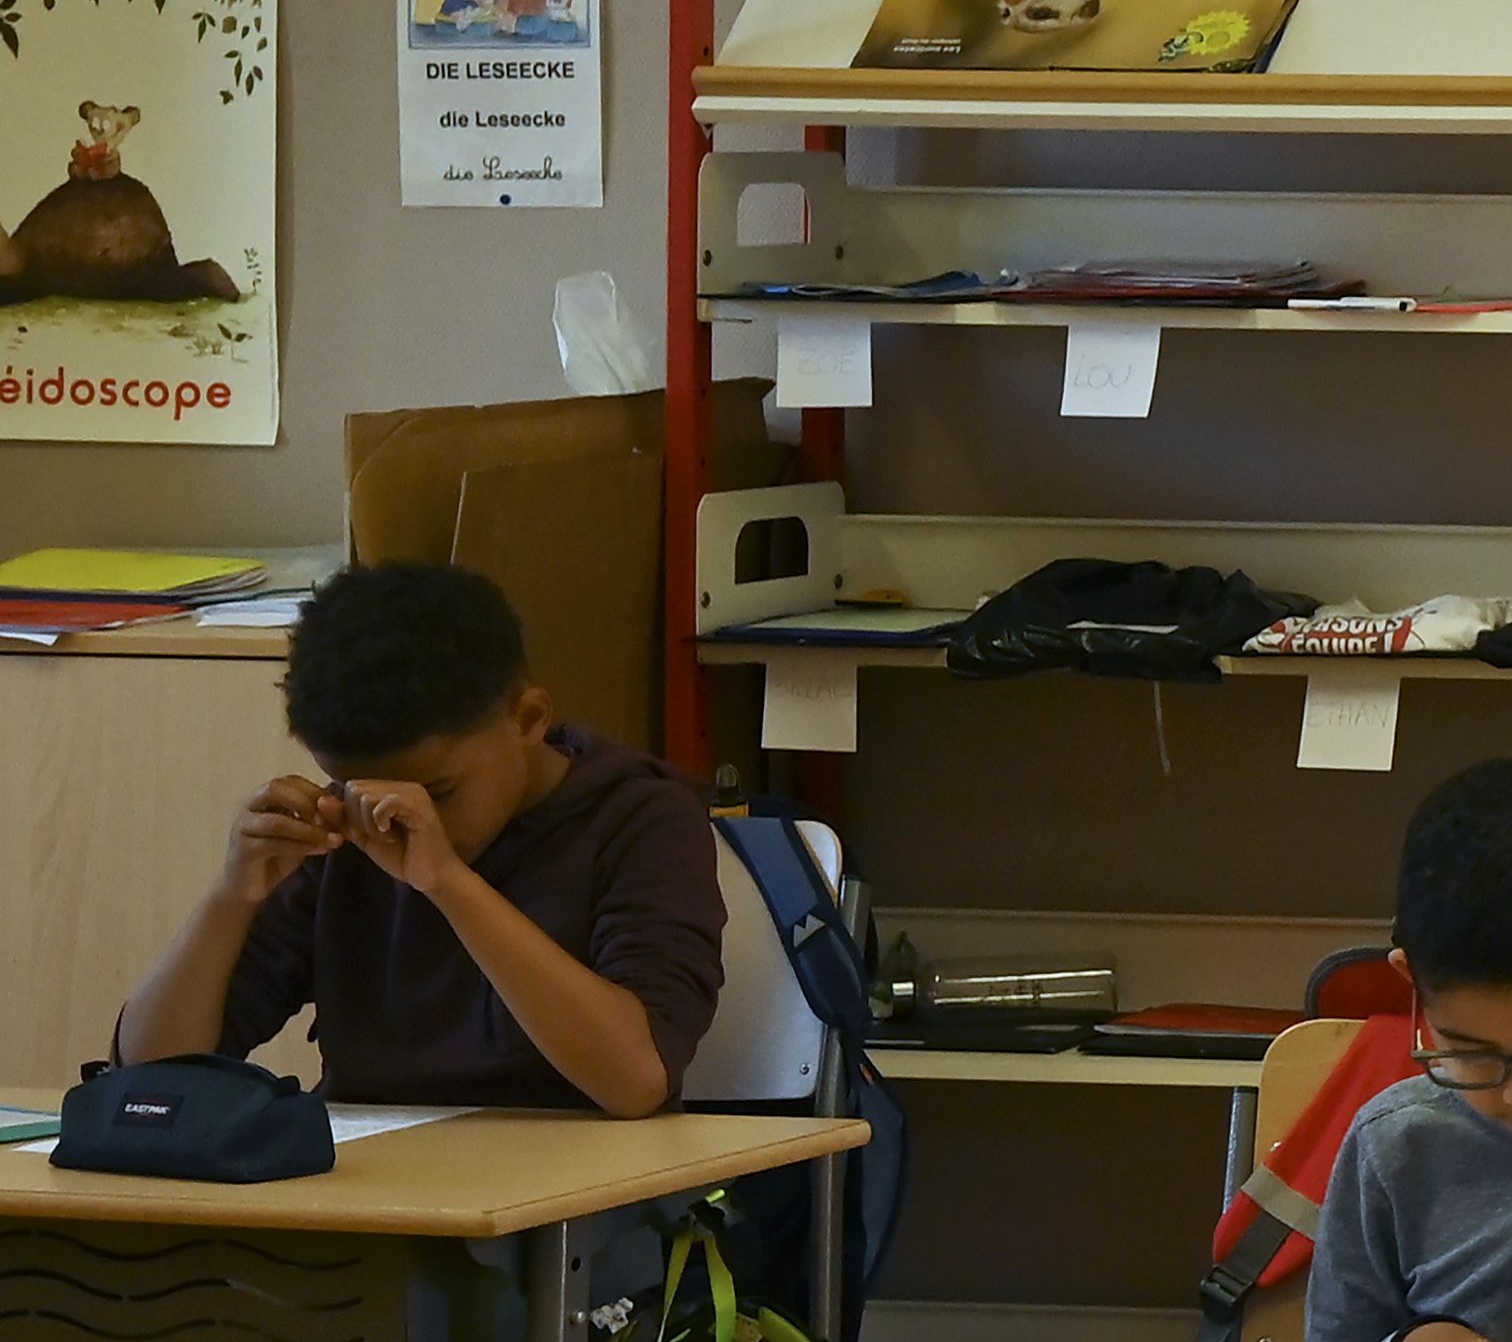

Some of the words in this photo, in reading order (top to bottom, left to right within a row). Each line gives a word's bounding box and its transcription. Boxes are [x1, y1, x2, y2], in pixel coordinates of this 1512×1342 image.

[426, 63, 459, 79] DIE
[467, 62, 575, 79] LESEECKE
[440, 111, 468, 127] die
[476, 111, 565, 127] Leseecke
[443, 165, 473, 181] die
[0, 366, 231, 420] éidoscope
[1308, 701, 1390, 727] ETHAN
[125, 1103, 171, 1115] EASTPAK
